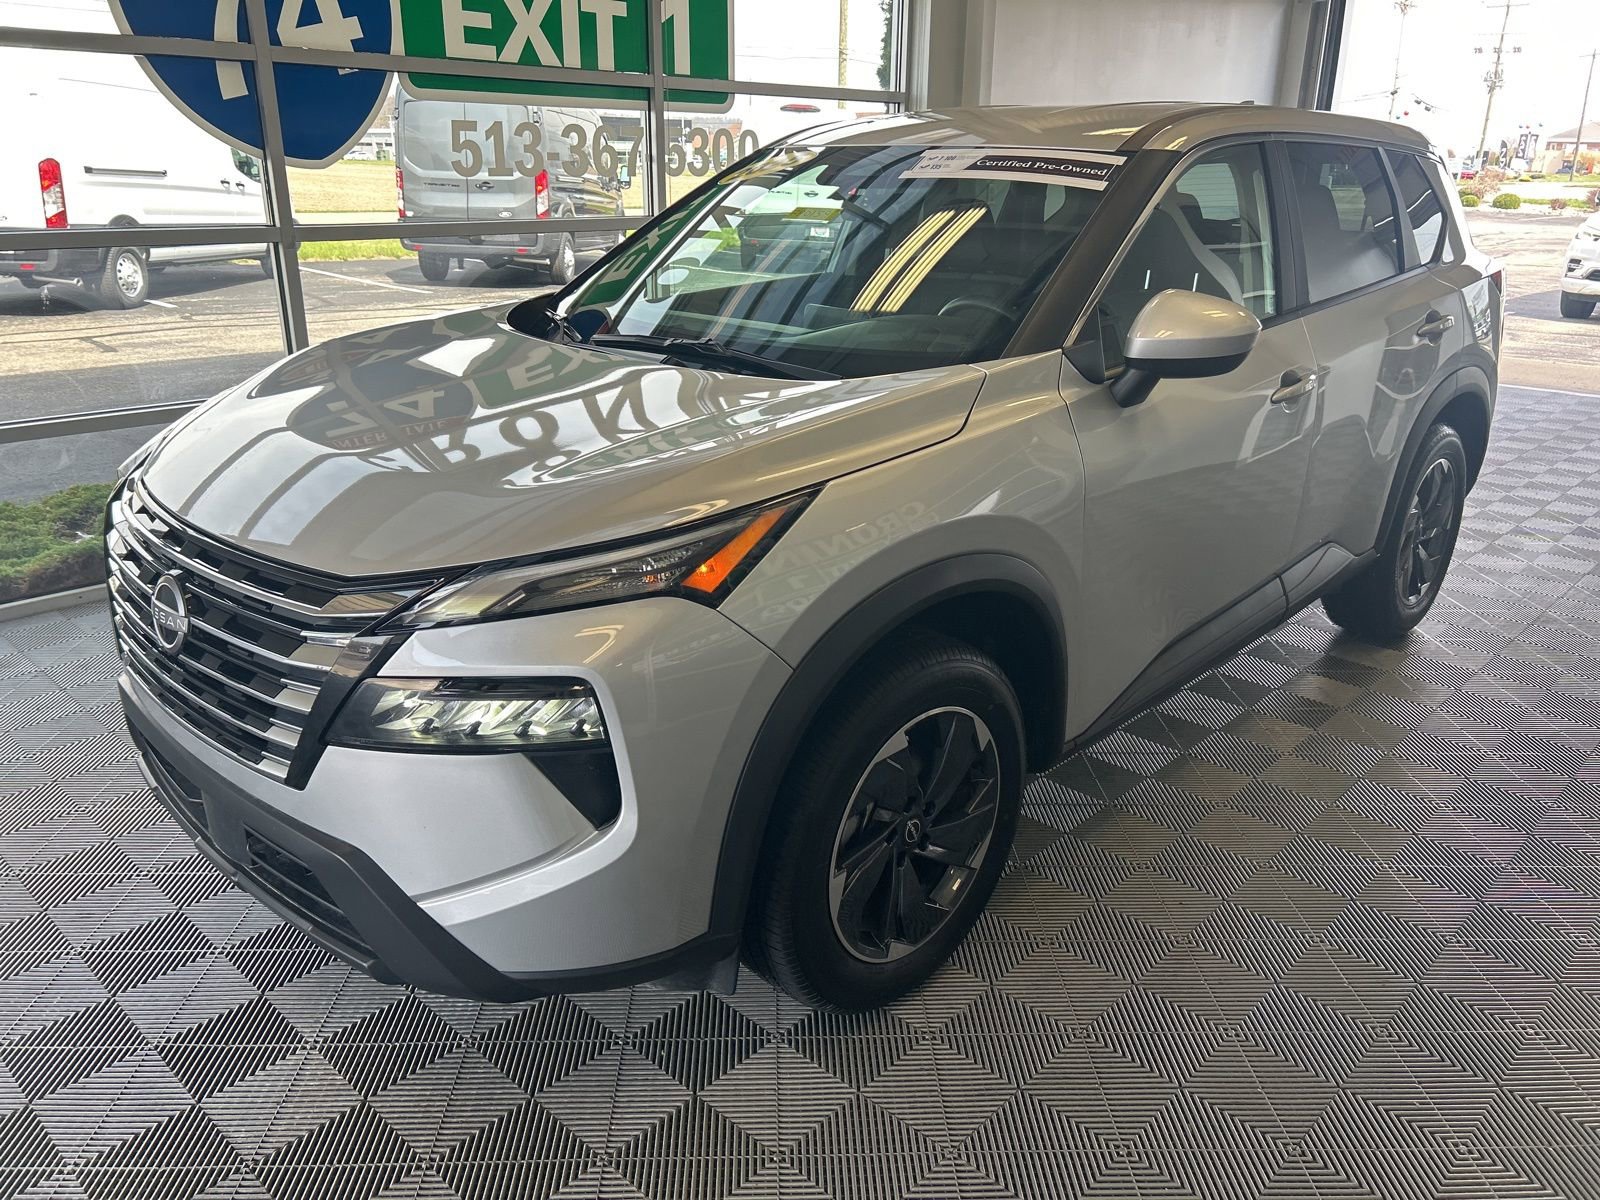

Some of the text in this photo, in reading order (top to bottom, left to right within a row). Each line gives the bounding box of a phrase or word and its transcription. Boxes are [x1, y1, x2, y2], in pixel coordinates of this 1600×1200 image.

[441, 0, 627, 70] EXIT
[976, 159, 1107, 176] Certified Pre-Owned
